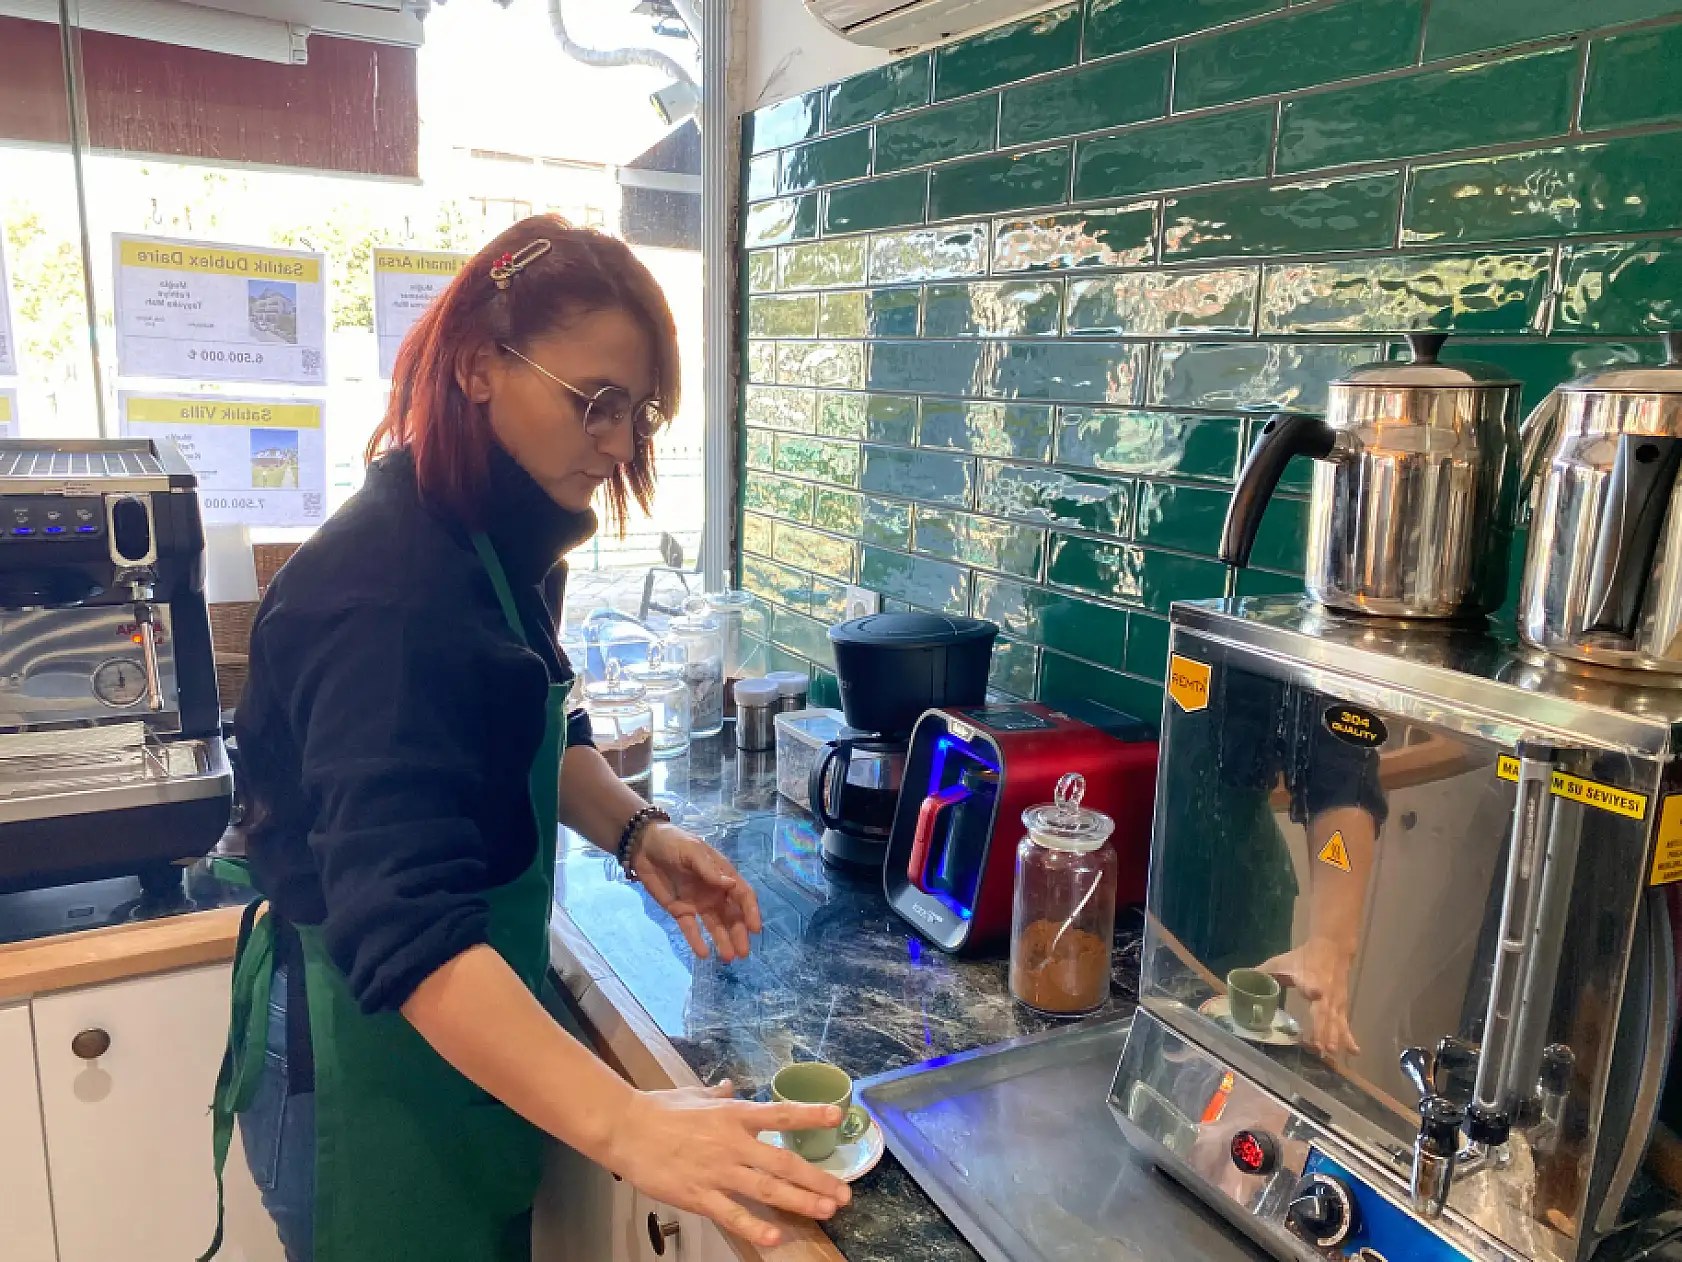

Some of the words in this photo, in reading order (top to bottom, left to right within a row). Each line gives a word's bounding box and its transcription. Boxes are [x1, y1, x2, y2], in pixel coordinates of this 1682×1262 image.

[1171, 673, 1207, 694] REMTA
[1340, 711, 1370, 729] 304
[1331, 720, 1378, 742] QUALITY
[1567, 781, 1584, 796] SU
